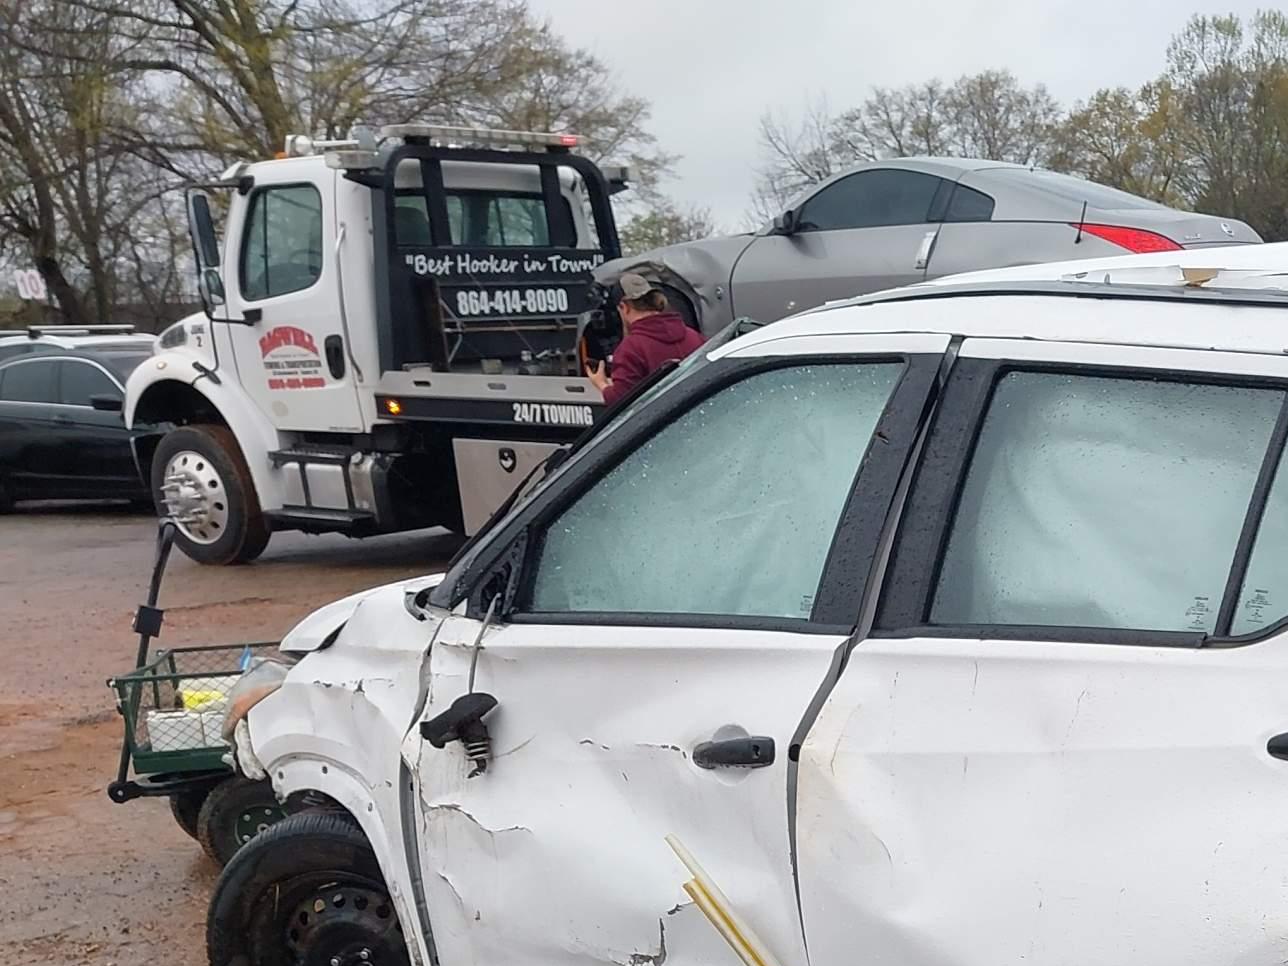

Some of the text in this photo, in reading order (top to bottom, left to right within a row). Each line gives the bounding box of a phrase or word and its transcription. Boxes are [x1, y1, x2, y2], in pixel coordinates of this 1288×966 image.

[406, 254, 453, 275] "Best
[456, 254, 516, 274] Hooker
[523, 254, 546, 272] in
[456, 288, 569, 316] 864-414-8090
[512, 402, 594, 426] 24/7 TOWING
